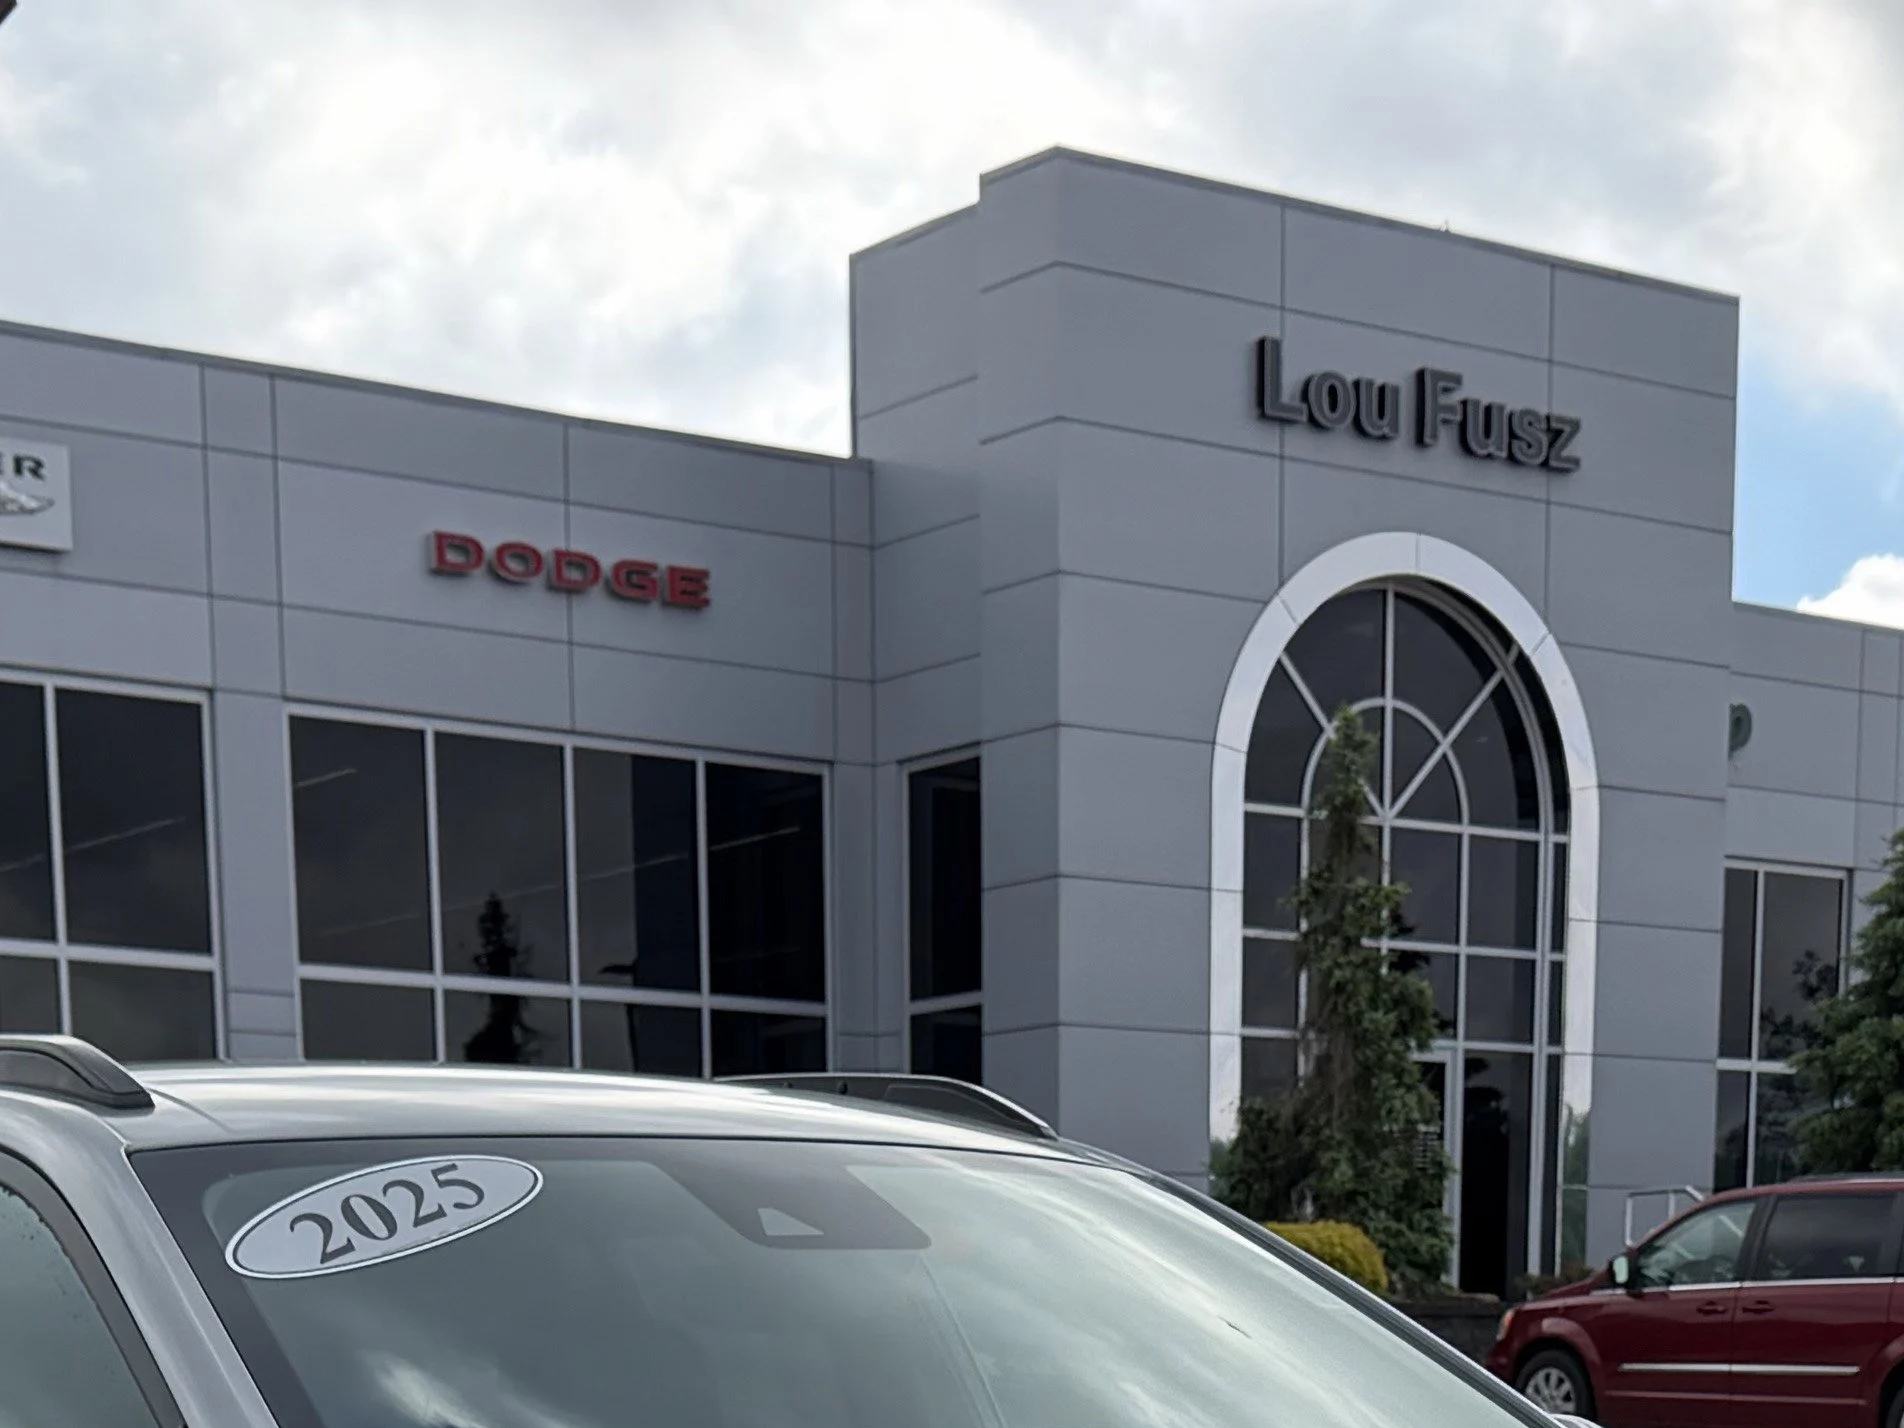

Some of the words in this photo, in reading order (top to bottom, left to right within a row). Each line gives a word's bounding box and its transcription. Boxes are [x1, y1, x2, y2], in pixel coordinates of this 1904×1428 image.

[1256, 336, 1400, 438] Lou
[1415, 367, 1582, 473] Fusz
[429, 530, 711, 609] DODGE
[289, 1163, 485, 1265] 2025
